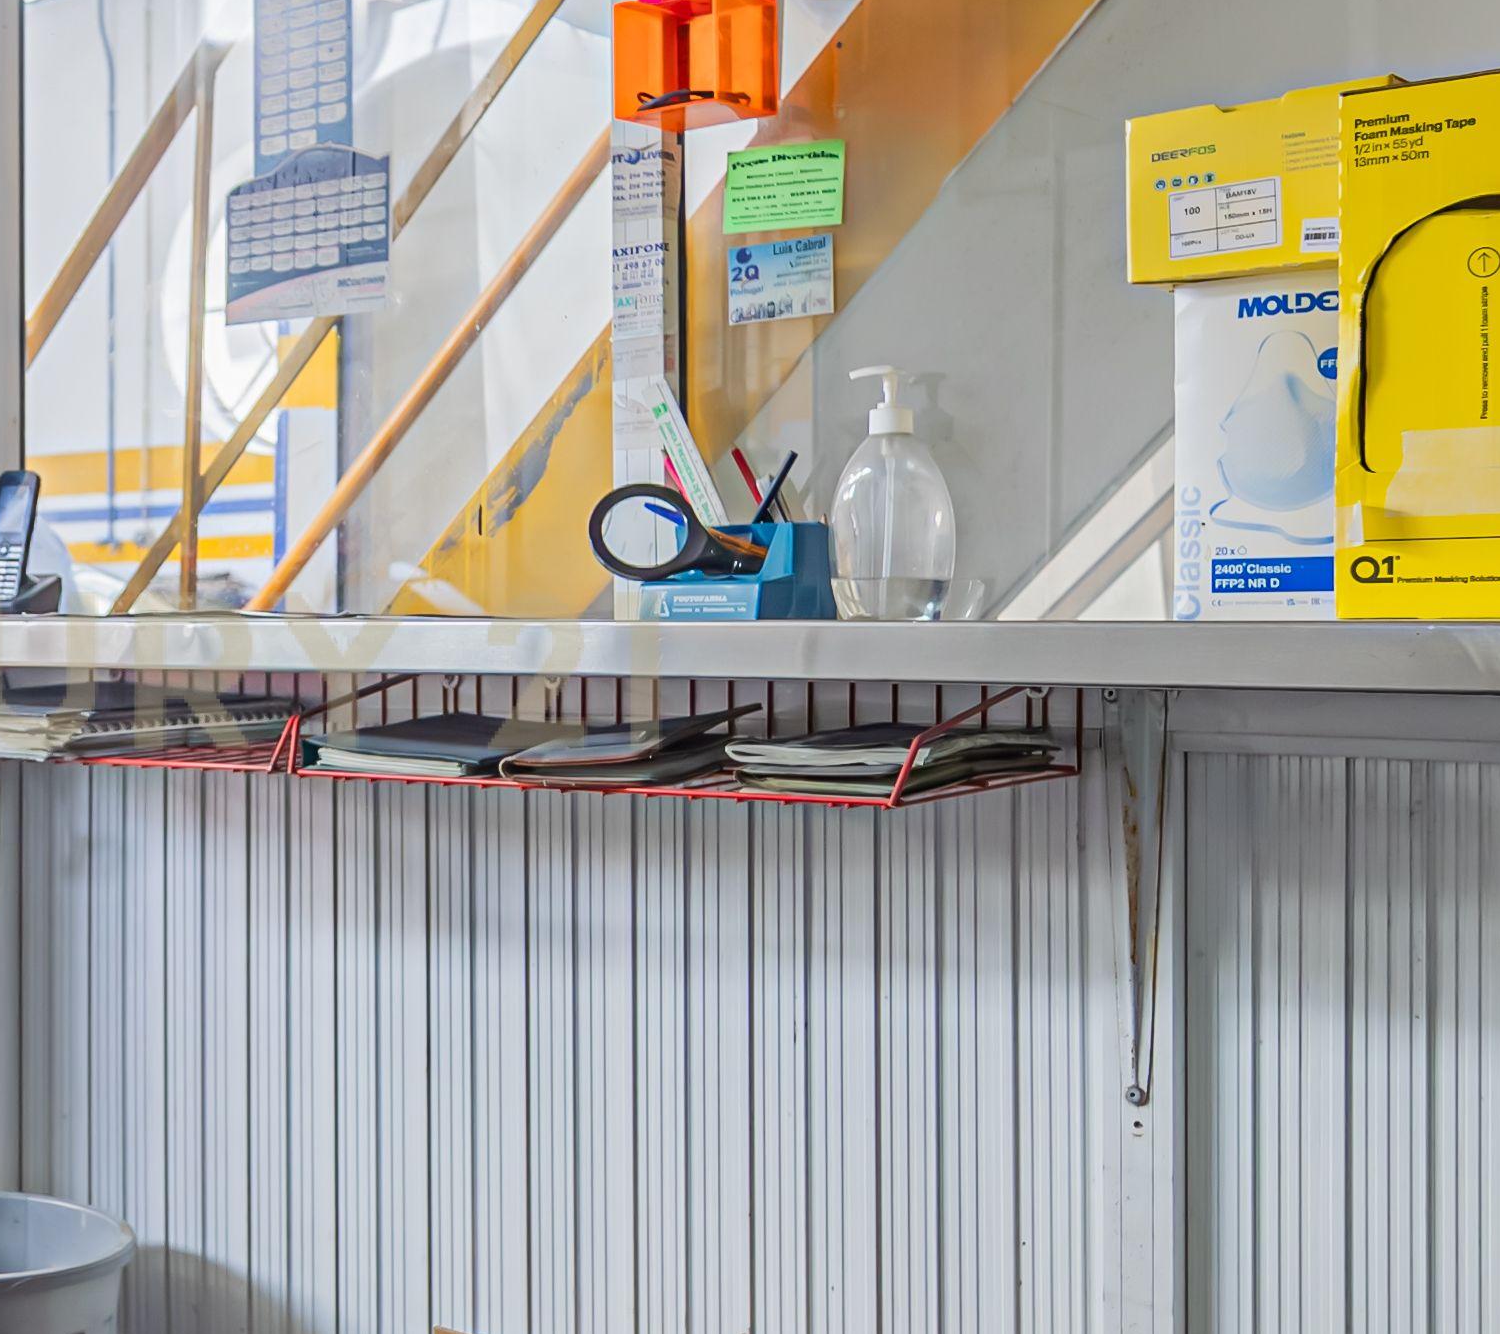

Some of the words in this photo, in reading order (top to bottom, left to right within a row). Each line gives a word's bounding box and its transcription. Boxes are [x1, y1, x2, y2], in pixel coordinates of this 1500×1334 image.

[1354, 113, 1409, 128] Premium
[1354, 129, 1387, 141] Foam
[1390, 122, 1442, 137] Masking
[1445, 117, 1476, 129] Tape
[1151, 145, 1216, 162] DEERFOS
[1354, 155, 1389, 167] 13mm
[1401, 150, 1429, 161] 50m
[1184, 206, 1200, 216] 100
[1238, 290, 1338, 318] MOLDE
[1176, 486, 1201, 621] Classic
[1215, 547, 1228, 556] 20
[1247, 563, 1292, 575] Classic
[1214, 578, 1245, 589] FFP2
[1248, 578, 1267, 589] NR
[1270, 578, 1280, 588] D
